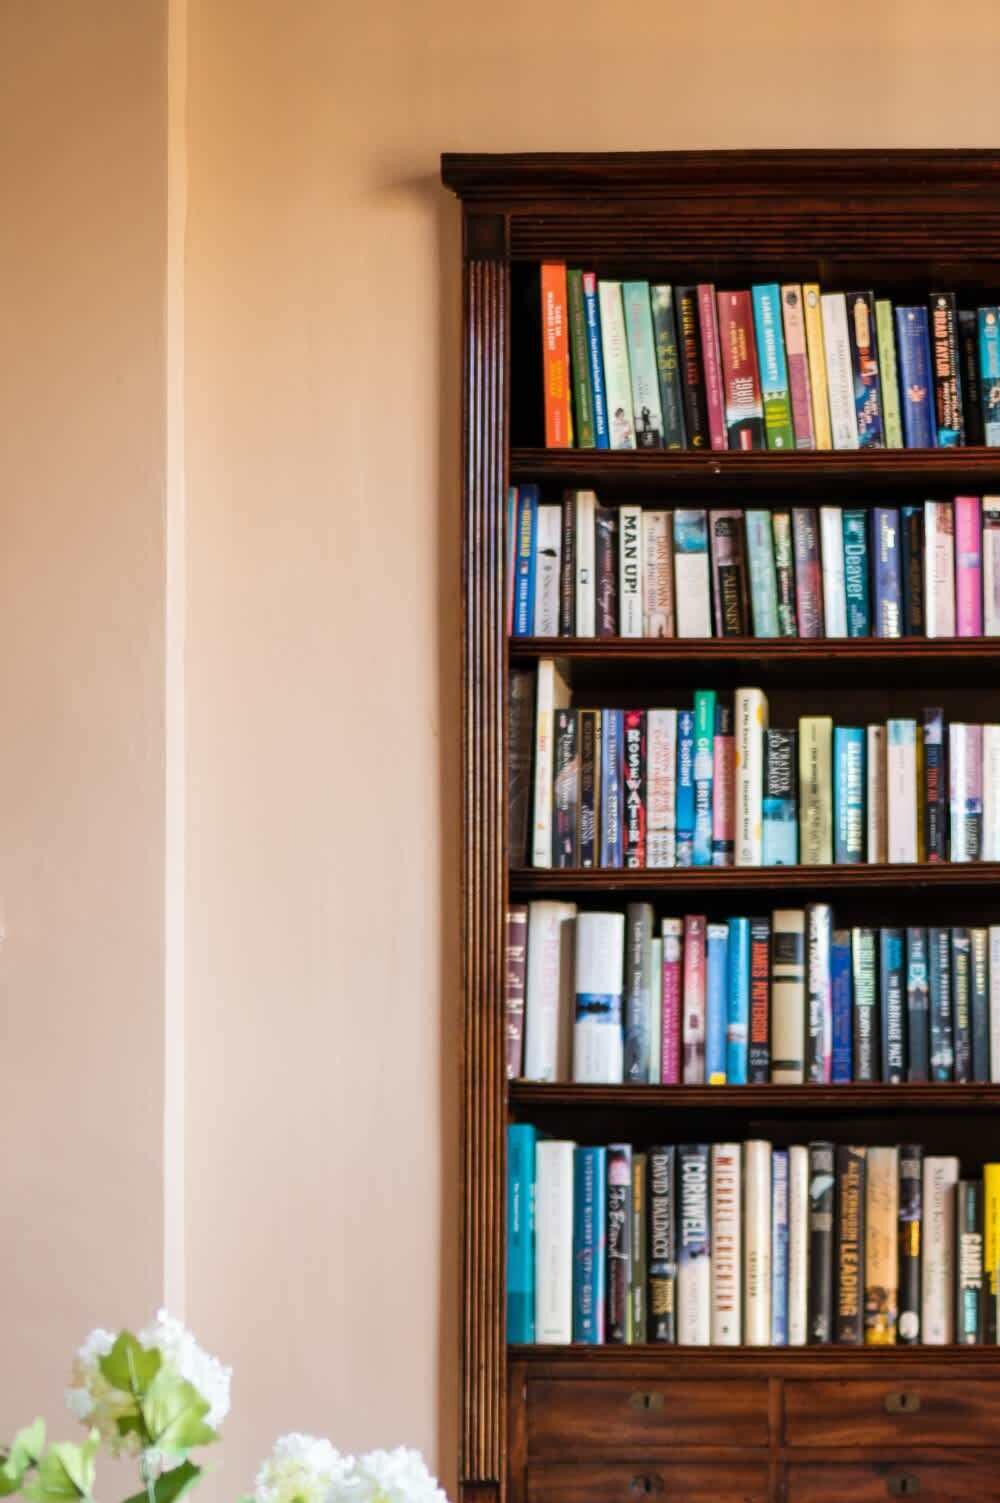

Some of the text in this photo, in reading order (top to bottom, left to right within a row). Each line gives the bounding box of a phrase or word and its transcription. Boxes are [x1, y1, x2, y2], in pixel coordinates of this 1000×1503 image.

[761, 296, 779, 382] LIANE MORIARTY
[934, 311, 950, 377] BRAD TAYLOR
[624, 515, 637, 593] MAN UP!
[845, 544, 866, 600] Deaver
[657, 563, 668, 607] BROWN
[722, 575, 739, 633] ALIENIST
[681, 739, 693, 786] Scotland
[768, 748, 780, 796] MEMORY
[780, 749, 791, 792] TRAITOR
[697, 781, 709, 831] BRITAIN
[751, 943, 768, 1043] JAMES PATTERSON
[888, 990, 901, 1040] MARRIAGE
[888, 1043, 902, 1068] PACT
[584, 1155, 593, 1203] ELIZABETH
[652, 1154, 669, 1193] DAVID
[652, 1196, 669, 1259] BALDACCI
[681, 1162, 706, 1246] CORNWELL
[608, 1210, 628, 1260] Brand
[715, 1156, 735, 1313] MICHAEL CRICHTON
[960, 1233, 982, 1289] GAMBLE
[839, 1244, 858, 1316] LEADING
